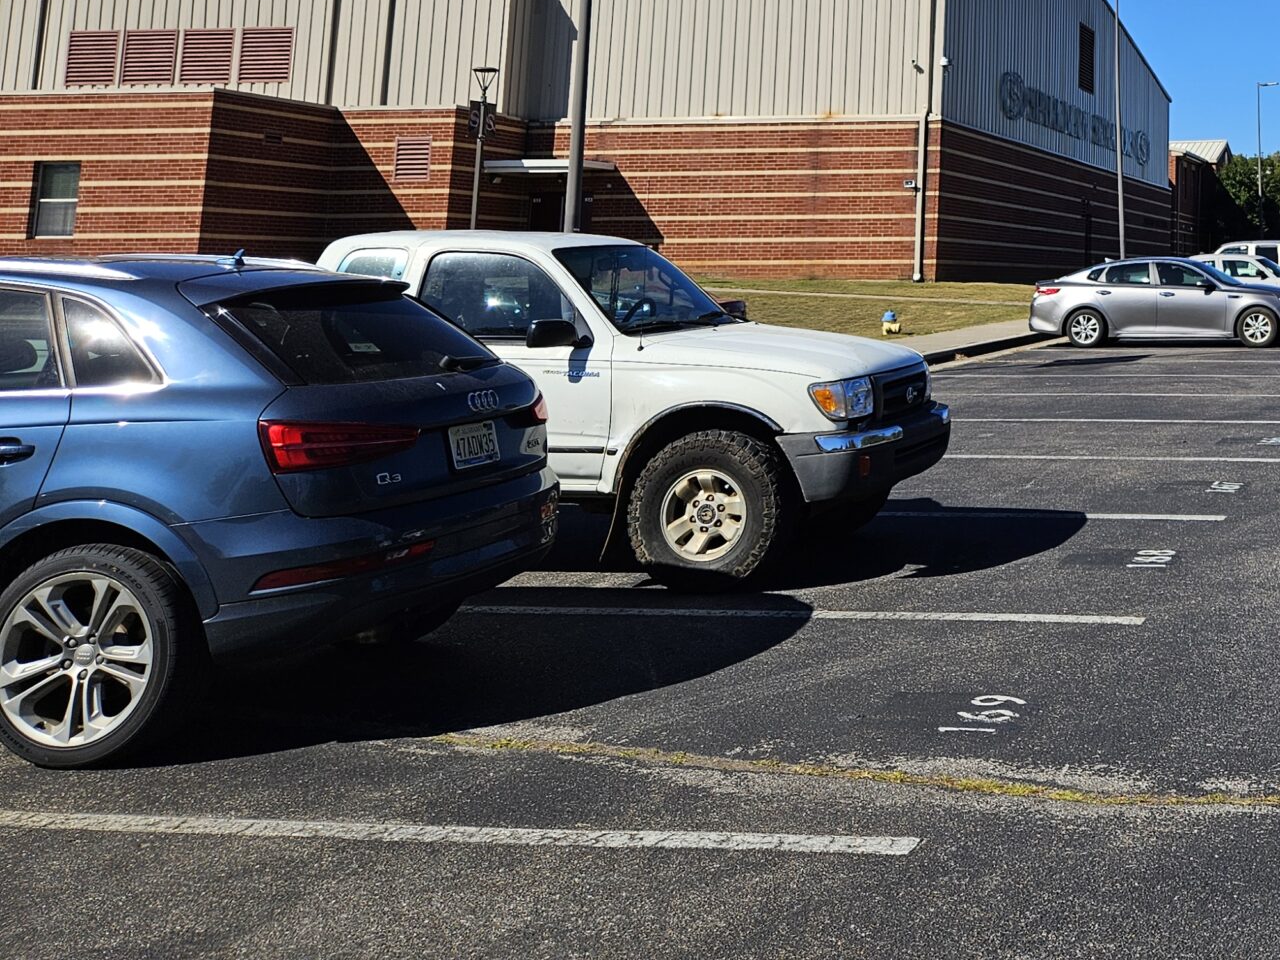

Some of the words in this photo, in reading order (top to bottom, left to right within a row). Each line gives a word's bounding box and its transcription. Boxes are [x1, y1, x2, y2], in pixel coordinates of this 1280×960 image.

[470, 110, 480, 127] S
[455, 432, 496, 460] 47ADW35
[376, 472, 402, 485] Q3
[937, 694, 1028, 732] 169
